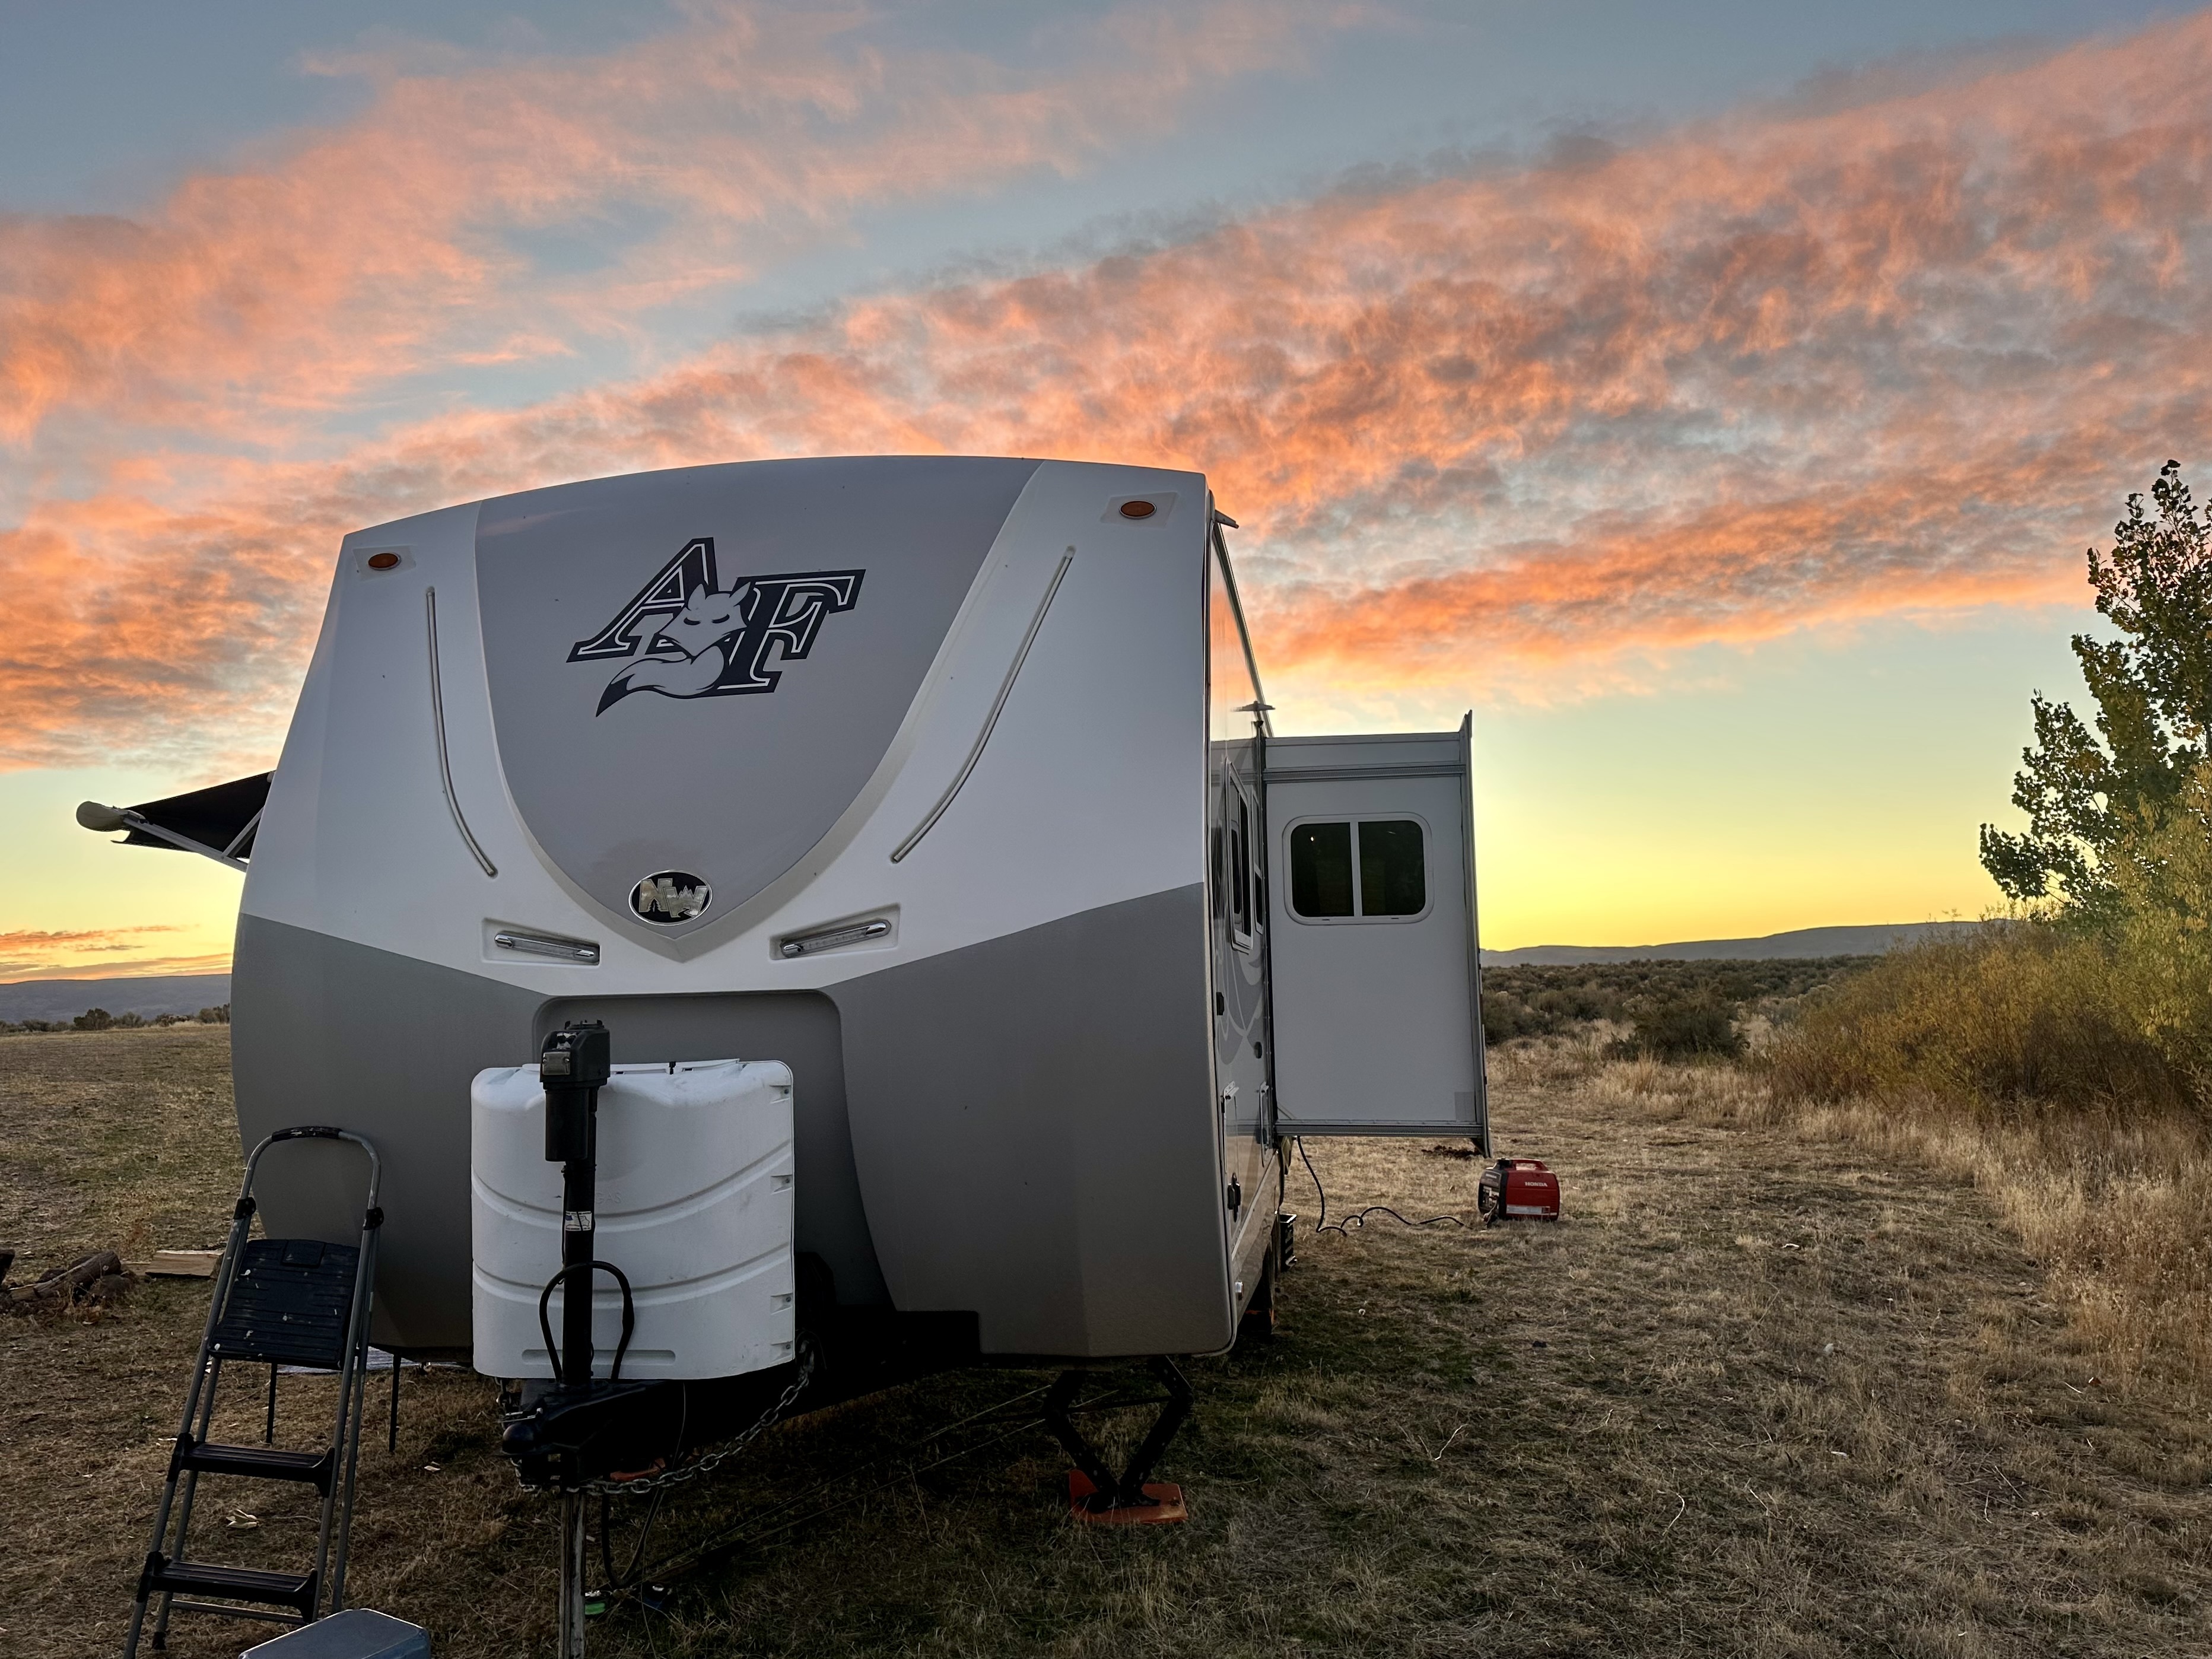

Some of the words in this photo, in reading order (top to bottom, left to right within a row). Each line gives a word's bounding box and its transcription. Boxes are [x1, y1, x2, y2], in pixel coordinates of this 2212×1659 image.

[566, 537, 866, 694] AF
[638, 878, 708, 918] NW
[596, 1191, 621, 1204] GAS
